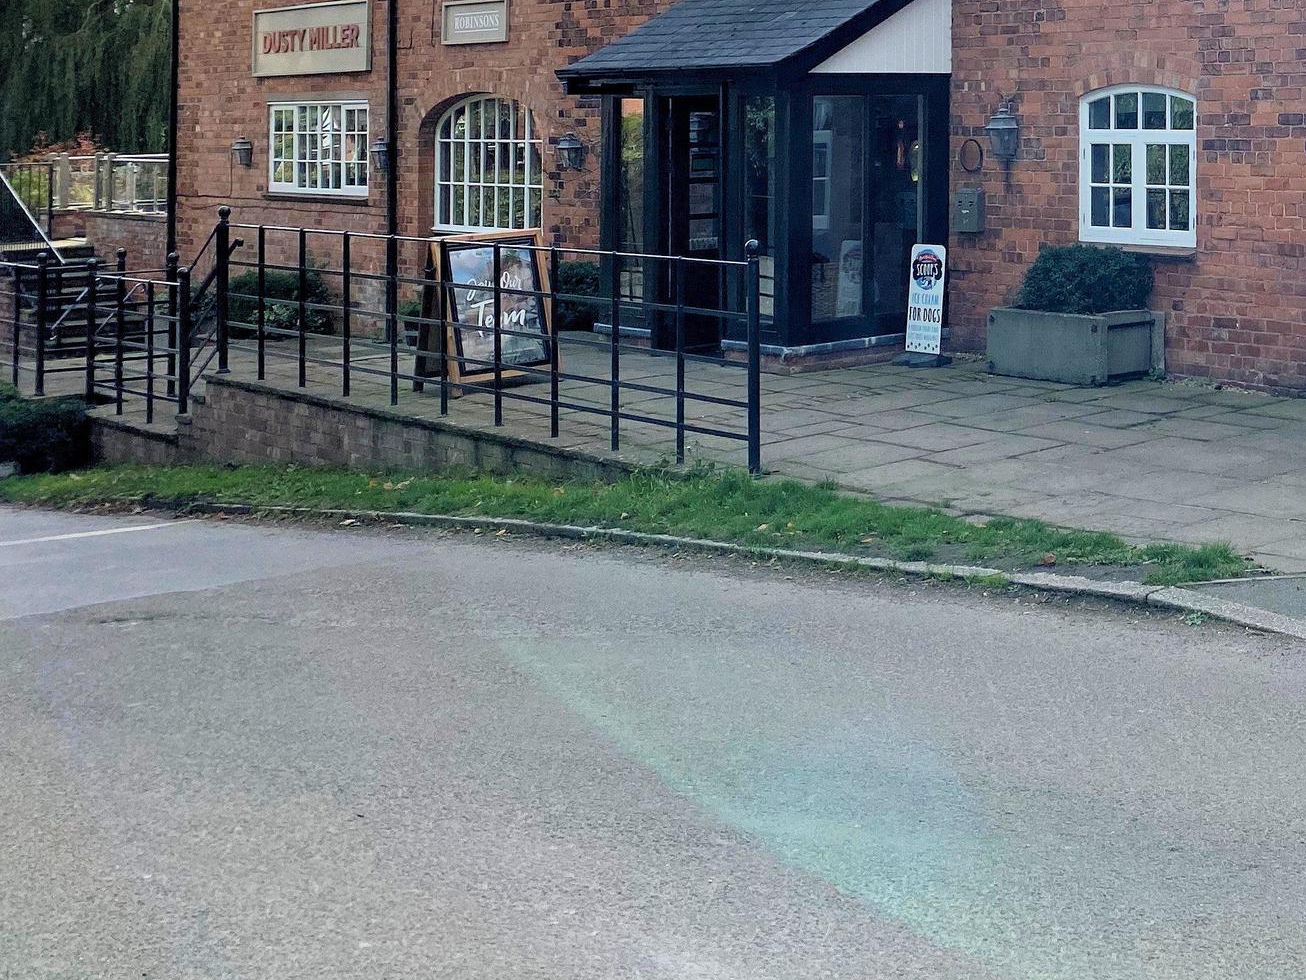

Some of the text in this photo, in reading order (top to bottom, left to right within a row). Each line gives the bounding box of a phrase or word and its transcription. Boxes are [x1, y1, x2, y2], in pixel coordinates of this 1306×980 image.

[454, 14, 499, 30] ROBINSONS
[263, 23, 360, 55] DUSTY MILLER
[500, 271, 522, 290] Our
[911, 292, 920, 305] ICE
[471, 298, 526, 337] Tem
[909, 306, 940, 323] FOR DOGS
